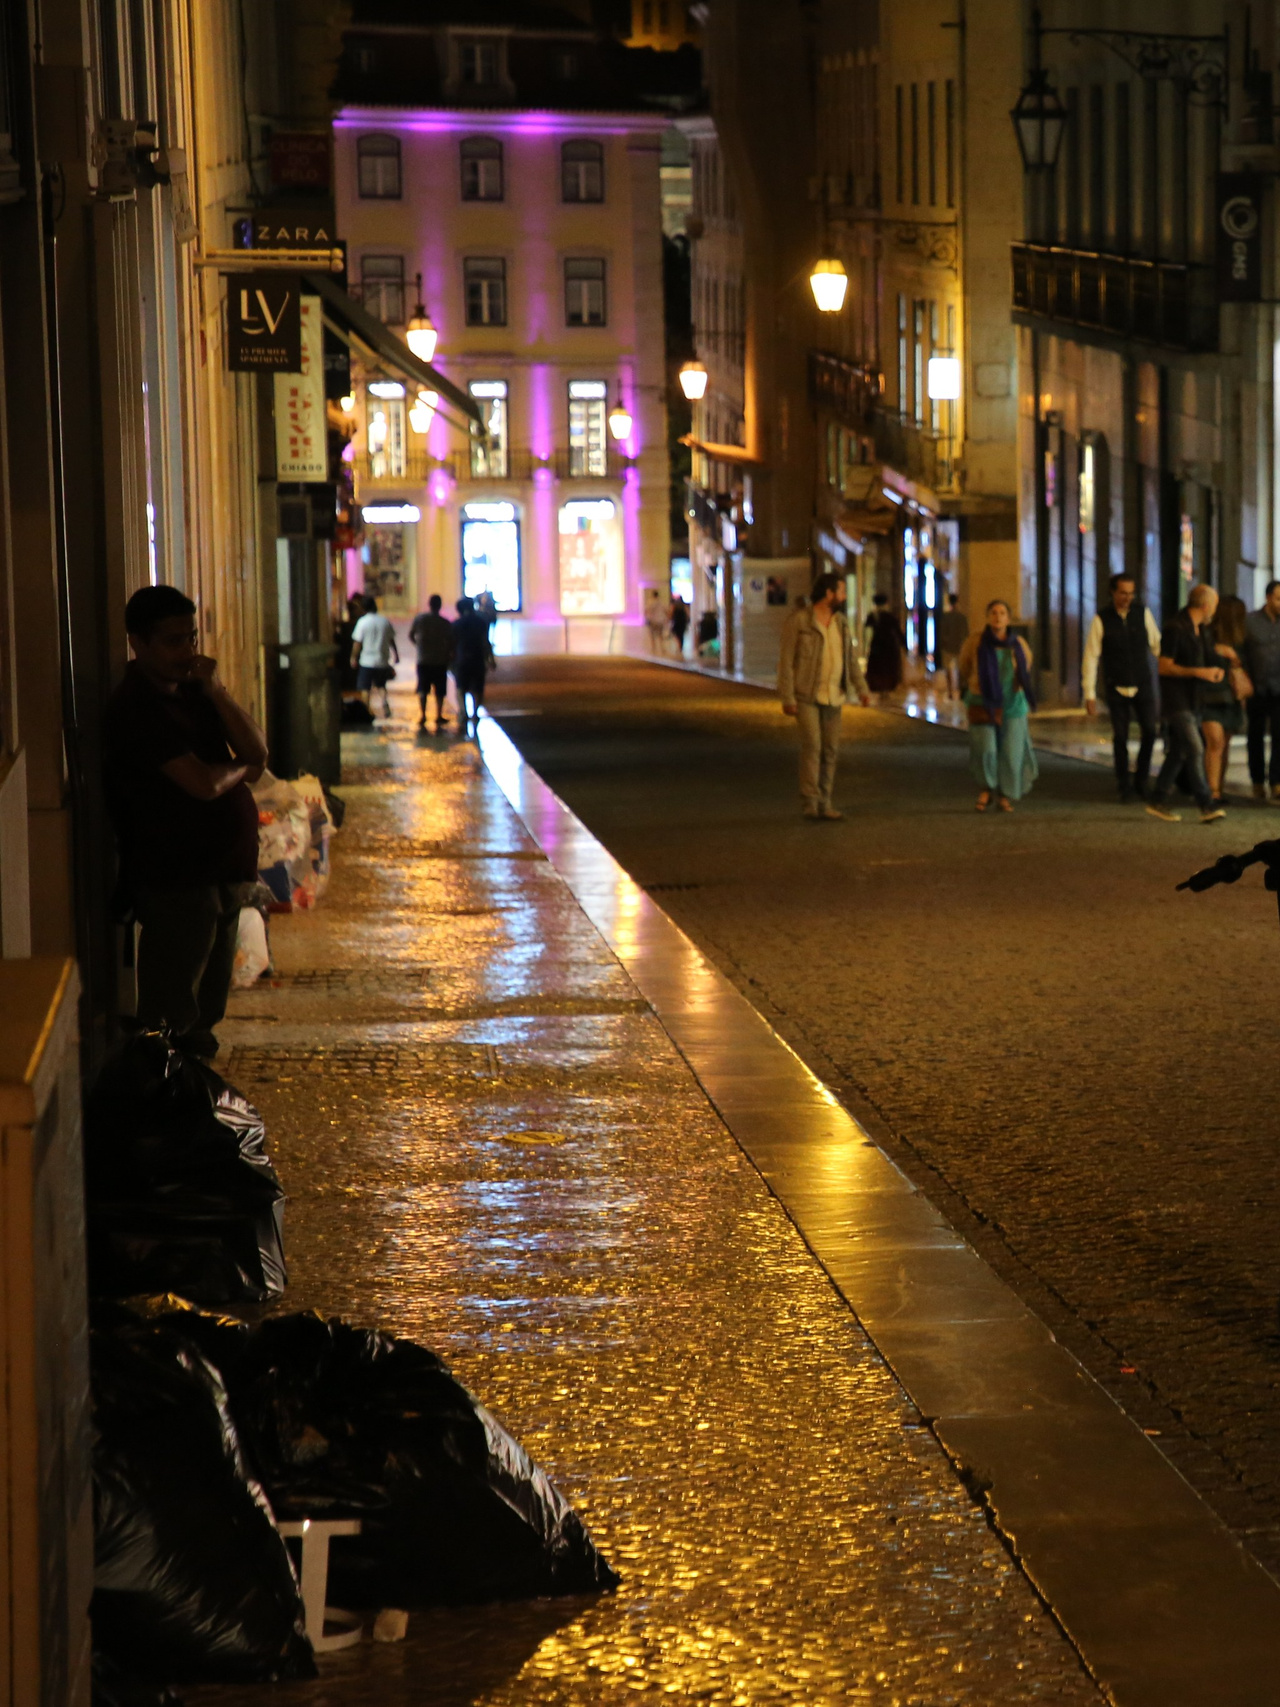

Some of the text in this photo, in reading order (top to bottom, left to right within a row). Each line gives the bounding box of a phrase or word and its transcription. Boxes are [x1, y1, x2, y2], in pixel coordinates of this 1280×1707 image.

[258, 226, 328, 241] ZARA
[1232, 242, 1247, 280] GMS
[241, 289, 289, 335] LV
